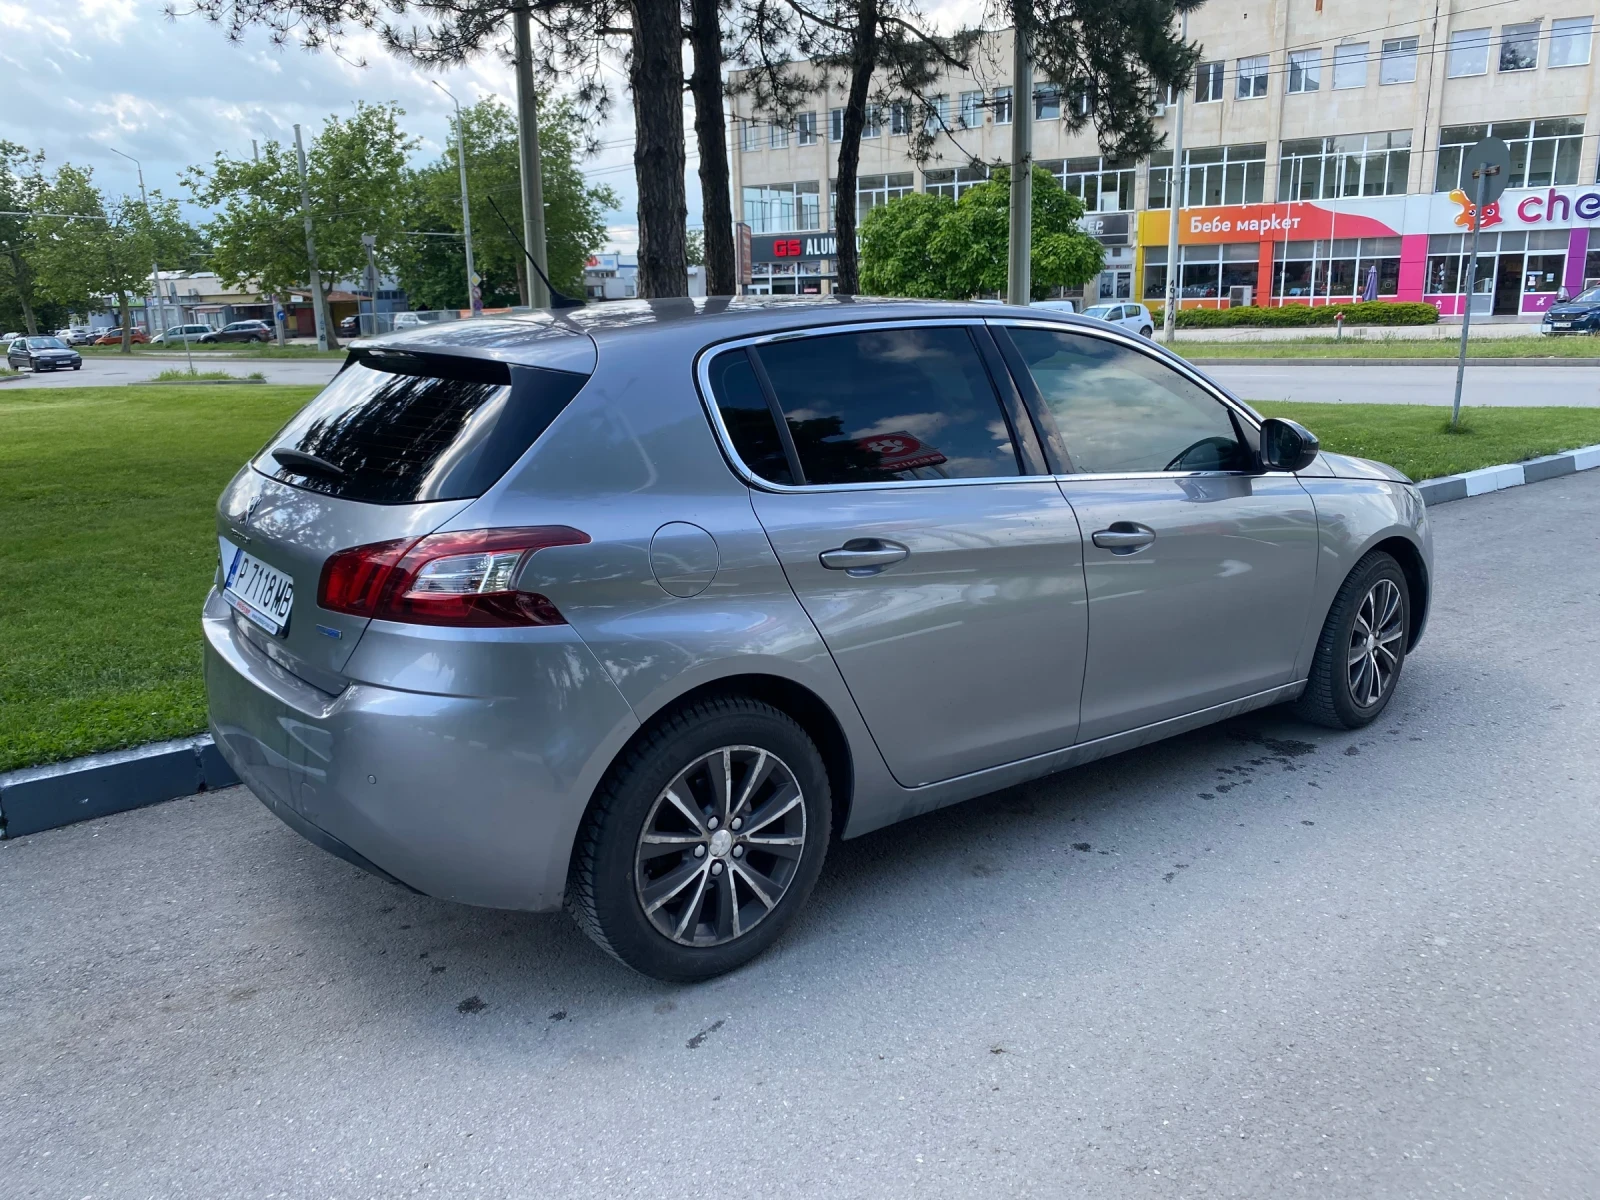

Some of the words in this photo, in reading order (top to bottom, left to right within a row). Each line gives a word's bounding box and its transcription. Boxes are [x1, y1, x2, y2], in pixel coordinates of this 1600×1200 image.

[1190, 216, 1231, 233] Бебе
[1236, 213, 1301, 235] маркет
[774, 239, 801, 257] GS
[235, 558, 249, 588] P
[245, 563, 277, 608] 7118
[270, 578, 294, 617] MB
